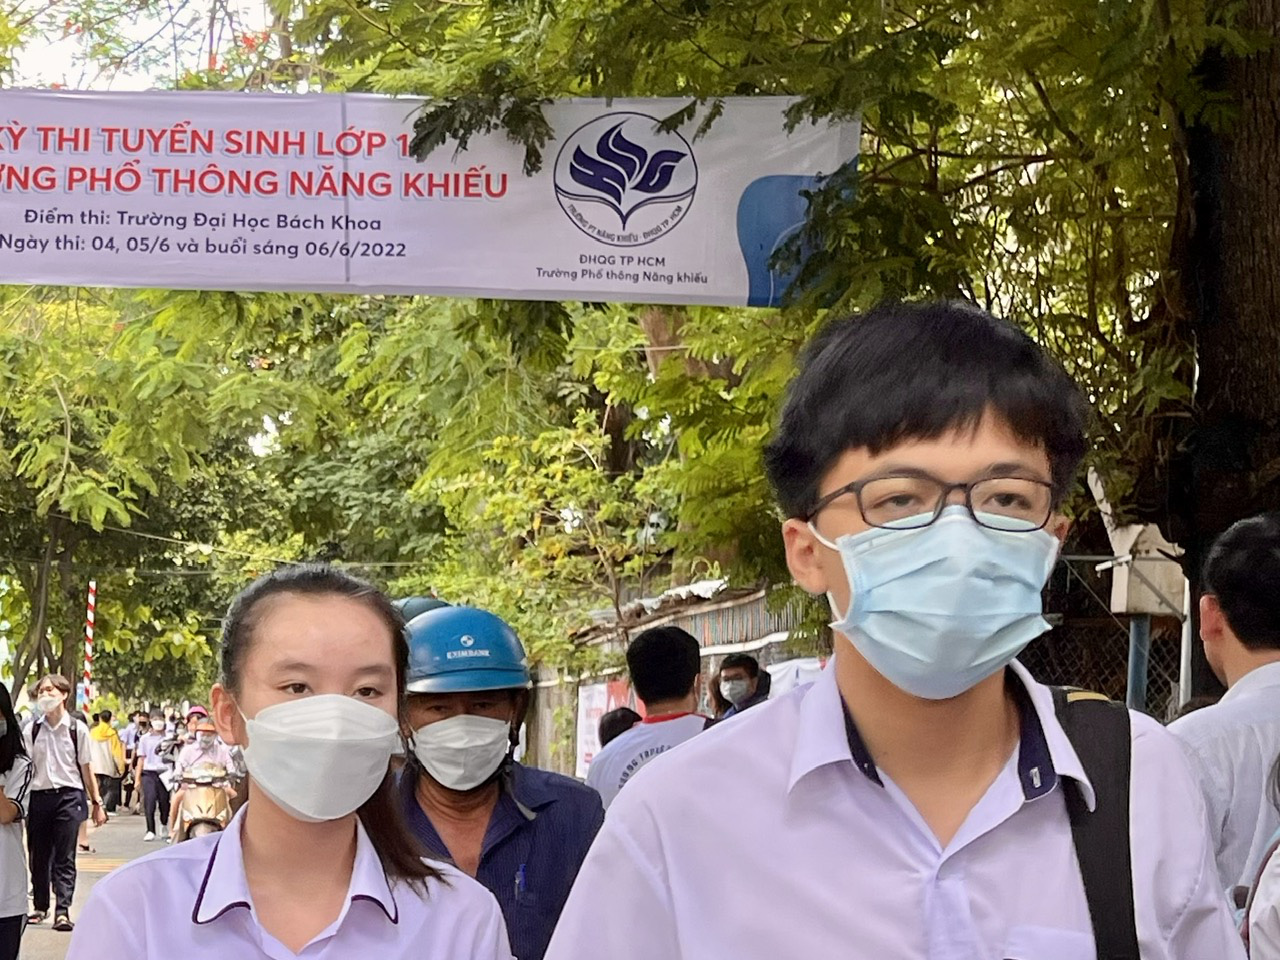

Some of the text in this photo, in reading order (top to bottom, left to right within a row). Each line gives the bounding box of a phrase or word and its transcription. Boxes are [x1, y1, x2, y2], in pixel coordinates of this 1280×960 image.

[36, 126, 91, 152] THI
[101, 121, 214, 154] TUYỂN
[224, 129, 305, 155] SINH
[317, 126, 387, 157] LỚP
[67, 159, 142, 192] PHỔ
[152, 163, 279, 194] THÔNG
[289, 165, 393, 197] NĂNG
[403, 165, 508, 199] KHIẾU
[24, 207, 381, 232] Điểm thi: Trường Đại Học Bách Khoa
[0, 233, 407, 259] Ngày thi: 04, 05/6 và buổi sáng 06/6/2022
[579, 253, 666, 267] ĐHQG TP HCM
[536, 267, 578, 282] Trường
[606, 270, 639, 284] thông
[643, 271, 674, 285] Năng
[677, 272, 708, 284] khiếu
